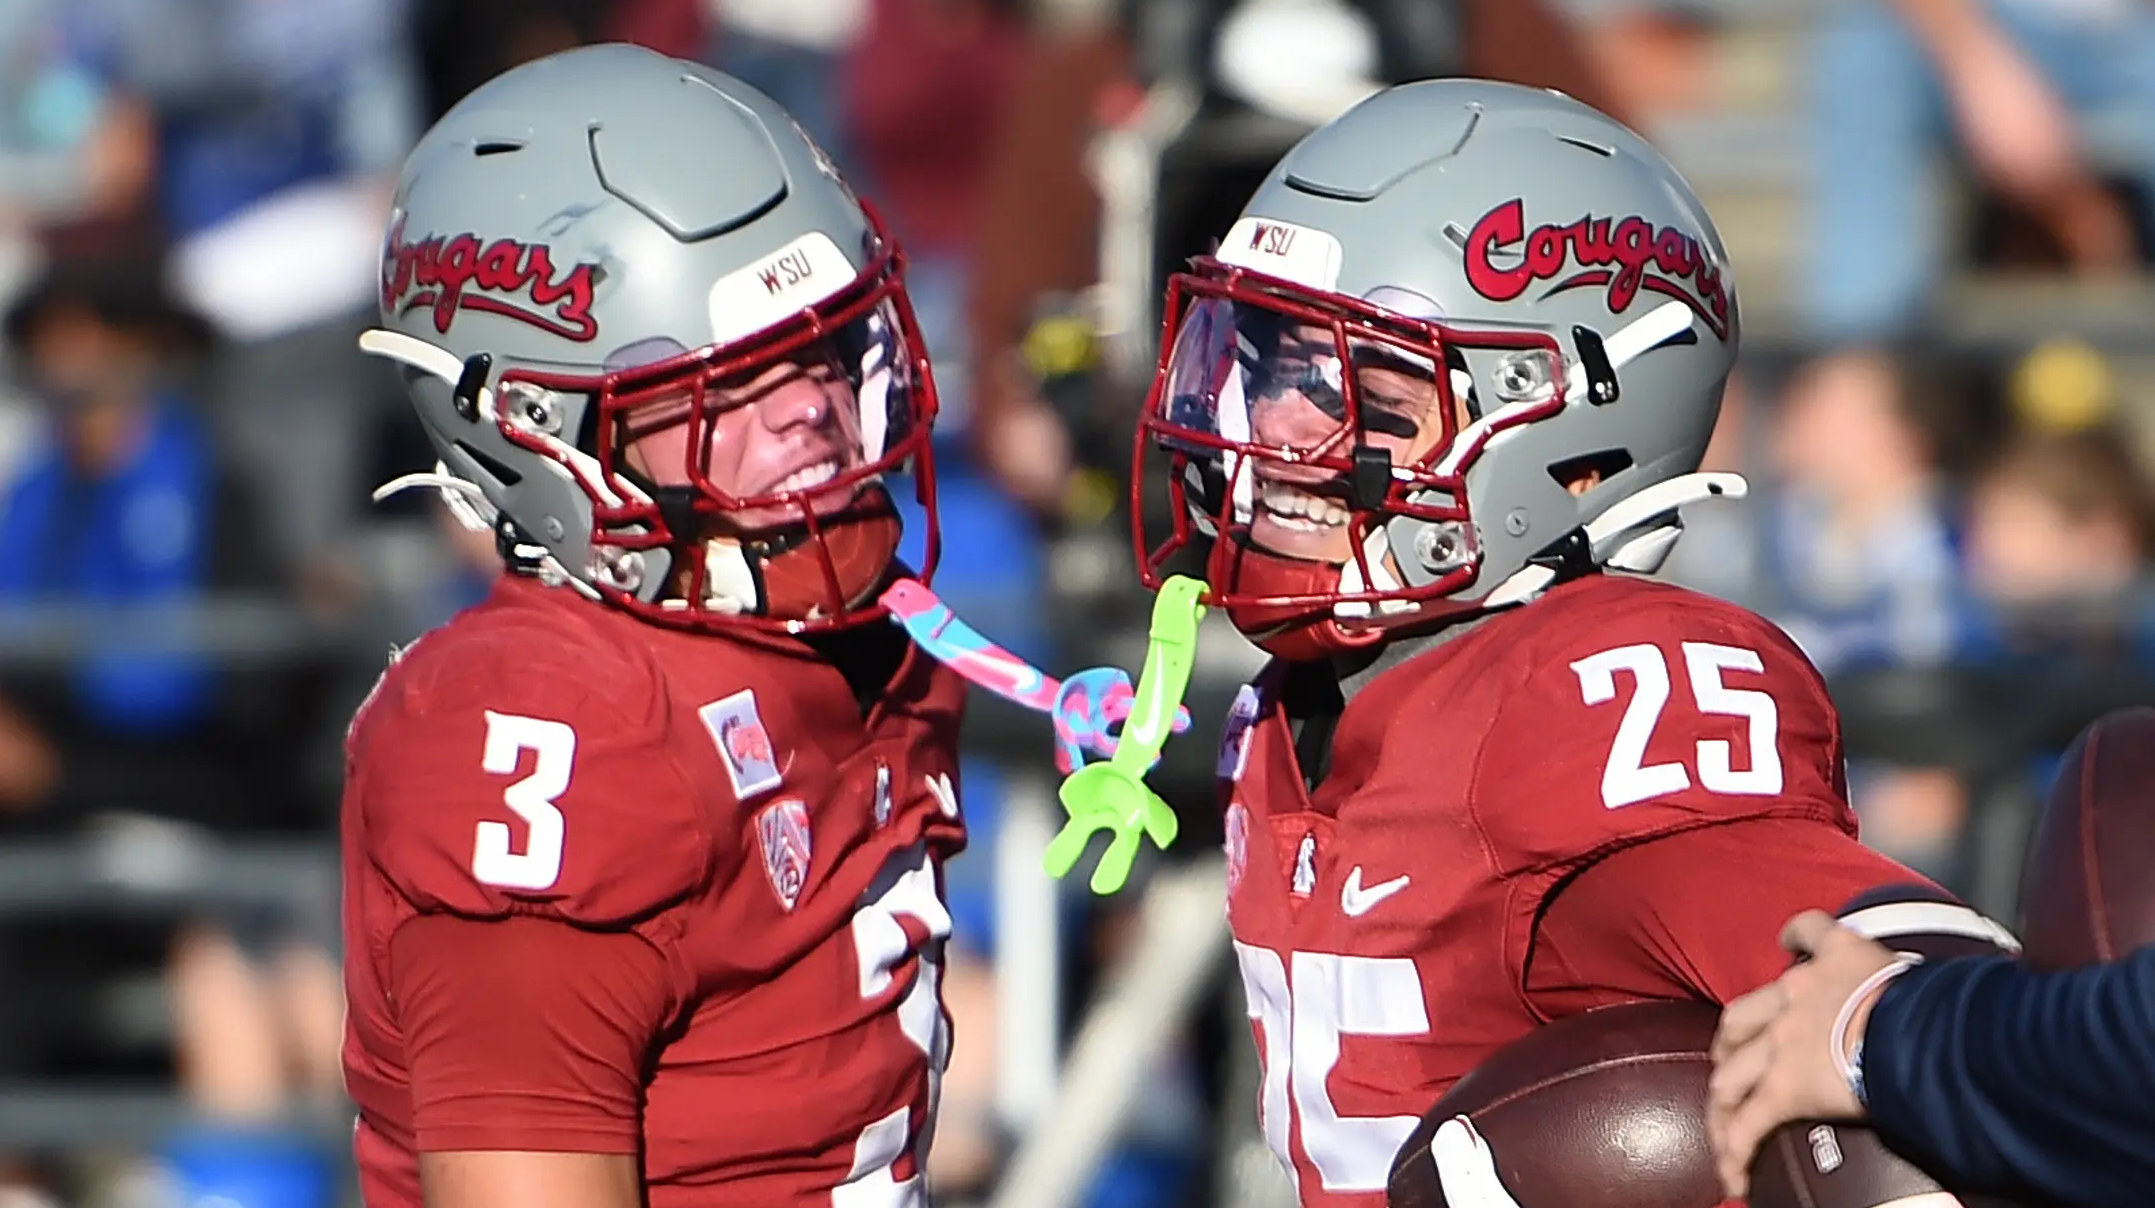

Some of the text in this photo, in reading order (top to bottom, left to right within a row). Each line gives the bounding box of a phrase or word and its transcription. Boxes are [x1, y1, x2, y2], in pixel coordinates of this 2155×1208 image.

[757, 249, 813, 296] WSU
[1249, 221, 1297, 256] WSU
[1464, 198, 1728, 341] Cougars
[1569, 641, 1784, 809] 25
[472, 709, 576, 890] 3
